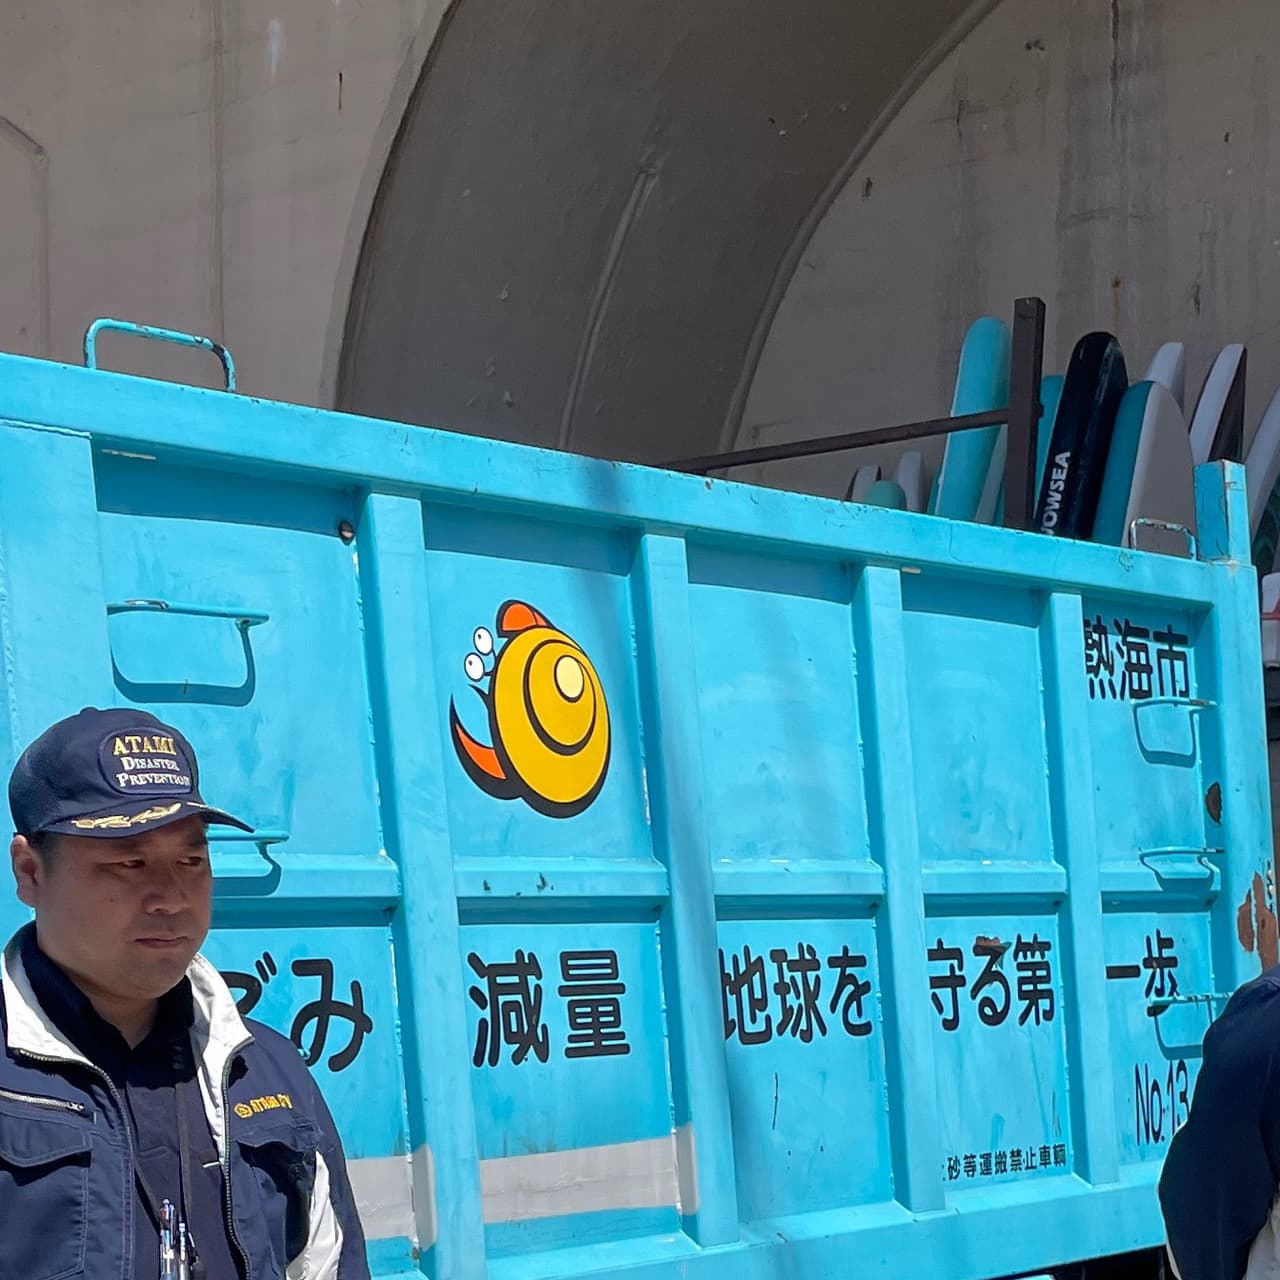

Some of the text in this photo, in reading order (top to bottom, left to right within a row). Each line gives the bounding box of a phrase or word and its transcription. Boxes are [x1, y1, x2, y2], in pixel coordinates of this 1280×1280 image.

[1083, 614, 1190, 701] 熱海市
[113, 735, 177, 756] ATAMI
[121, 756, 180, 772] DISASTER
[116, 772, 191, 788] PREVENTION
[467, 949, 631, 1068] 減量
[718, 941, 873, 1046] 地球を
[927, 934, 1055, 1032] 守る第
[1106, 928, 1179, 1017] 一歩
